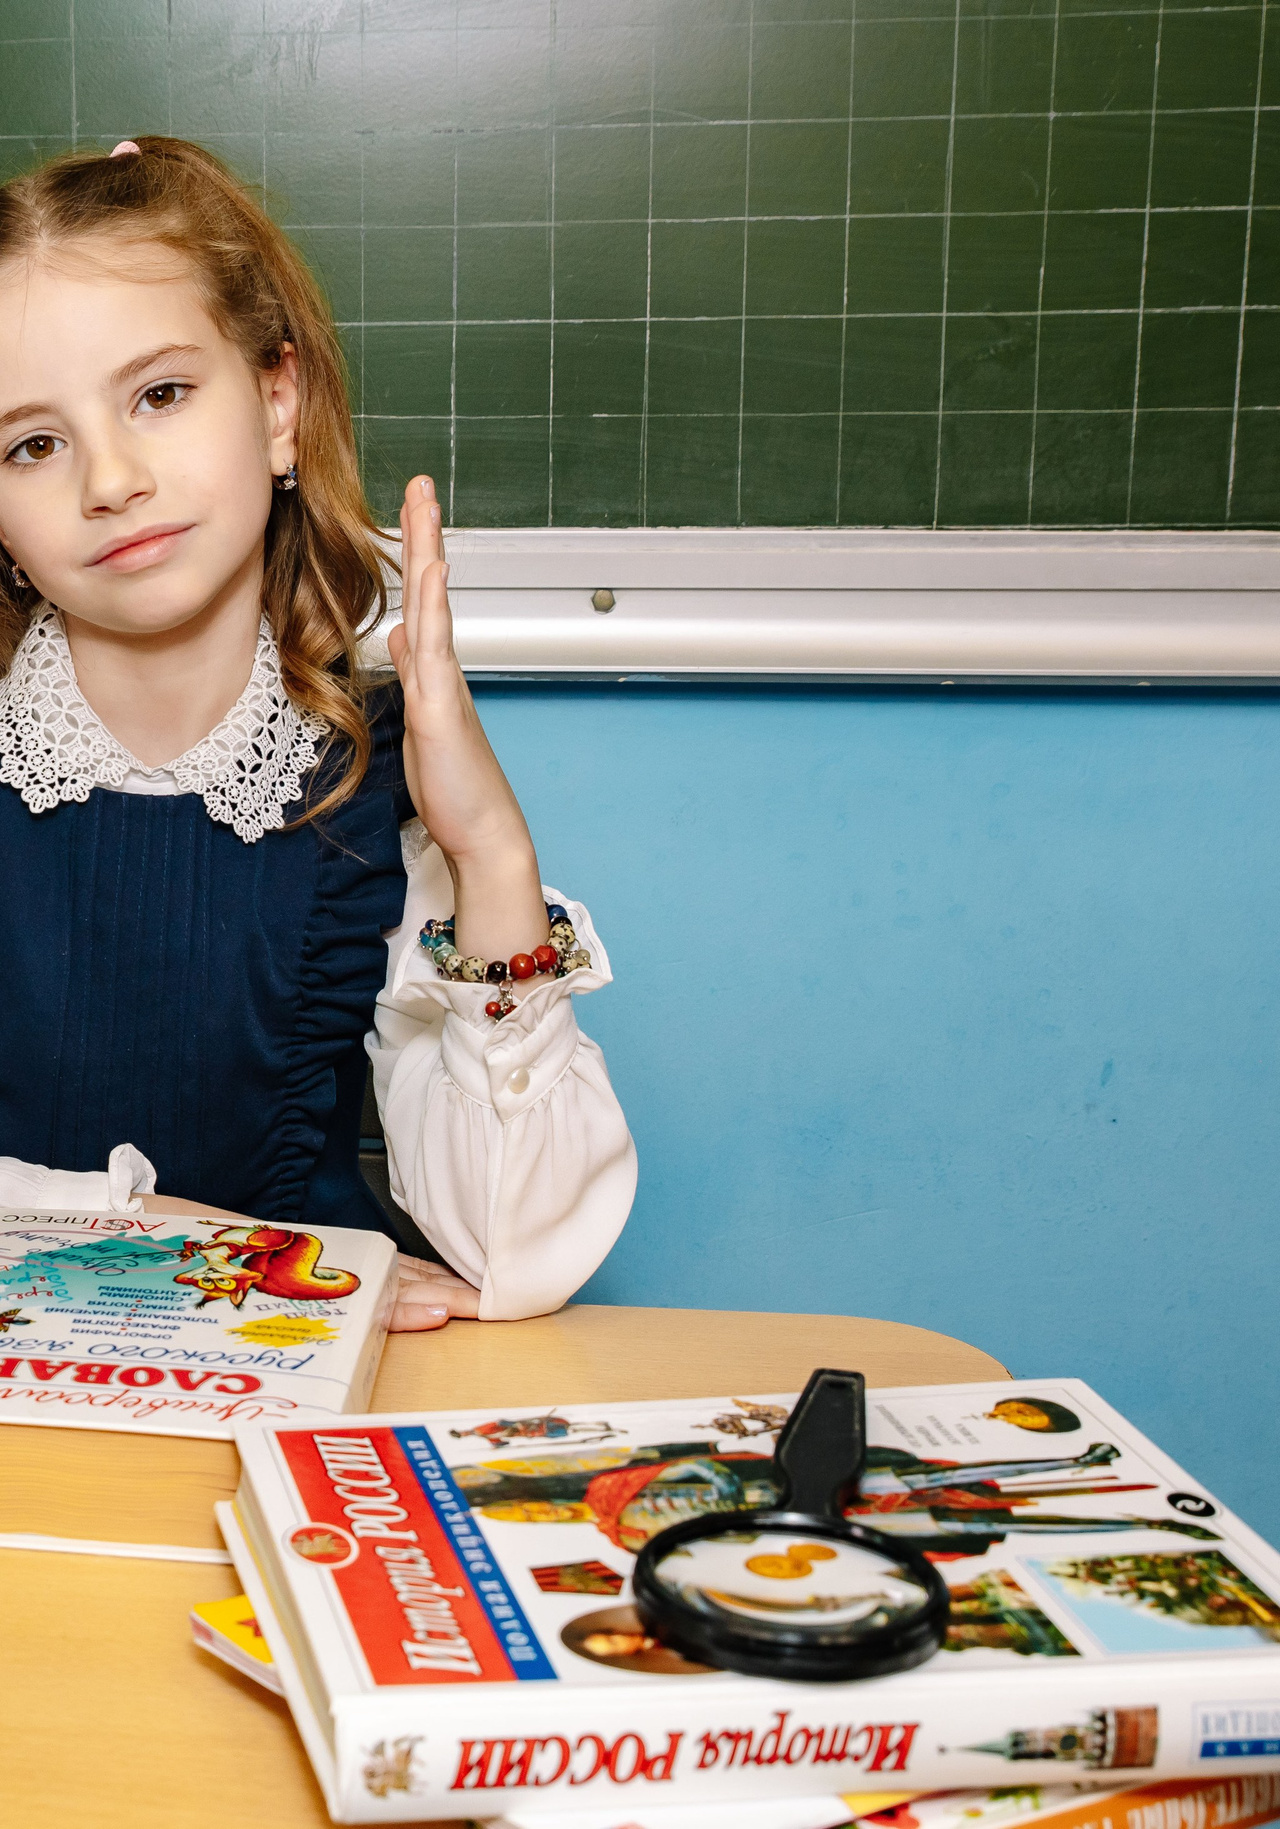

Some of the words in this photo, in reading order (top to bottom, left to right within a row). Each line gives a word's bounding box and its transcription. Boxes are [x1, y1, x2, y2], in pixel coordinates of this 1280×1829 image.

[98, 1285, 180, 1296] АНТОНИМЫ
[99, 1291, 184, 1303] СИНОНИМЫ
[43, 1306, 120, 1317] ЗНАЧЕНИЙ
[87, 1300, 187, 1312] ЭТИМОЛОГИЯ
[123, 1311, 219, 1324] ТОЛКОВАНИЕ
[72, 1318, 181, 1330] ФРАЗЕОЛОГИЯ
[70, 1328, 172, 1340] ОРФОГРАФИЯ
[87, 1342, 315, 1370] русского
[312, 1434, 419, 1542] РОССИИ
[375, 1545, 483, 1677] История
[695, 1710, 921, 1773] История
[448, 1731, 685, 1790] РОССИИ
